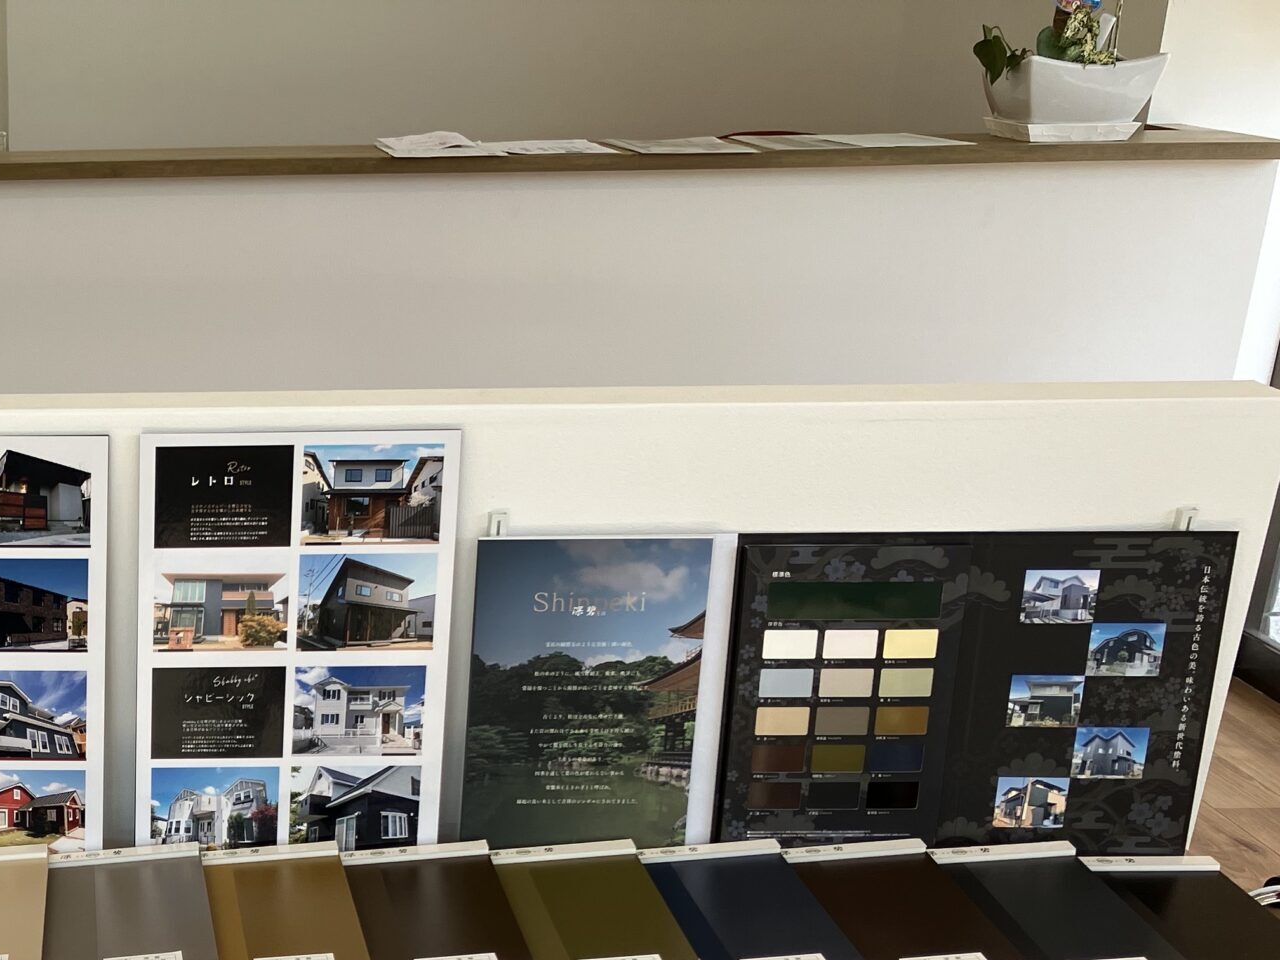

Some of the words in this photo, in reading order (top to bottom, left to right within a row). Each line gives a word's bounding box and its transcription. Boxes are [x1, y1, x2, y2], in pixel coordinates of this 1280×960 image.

[191, 476, 234, 486] レトロ
[184, 693, 255, 702] シャビーシック
